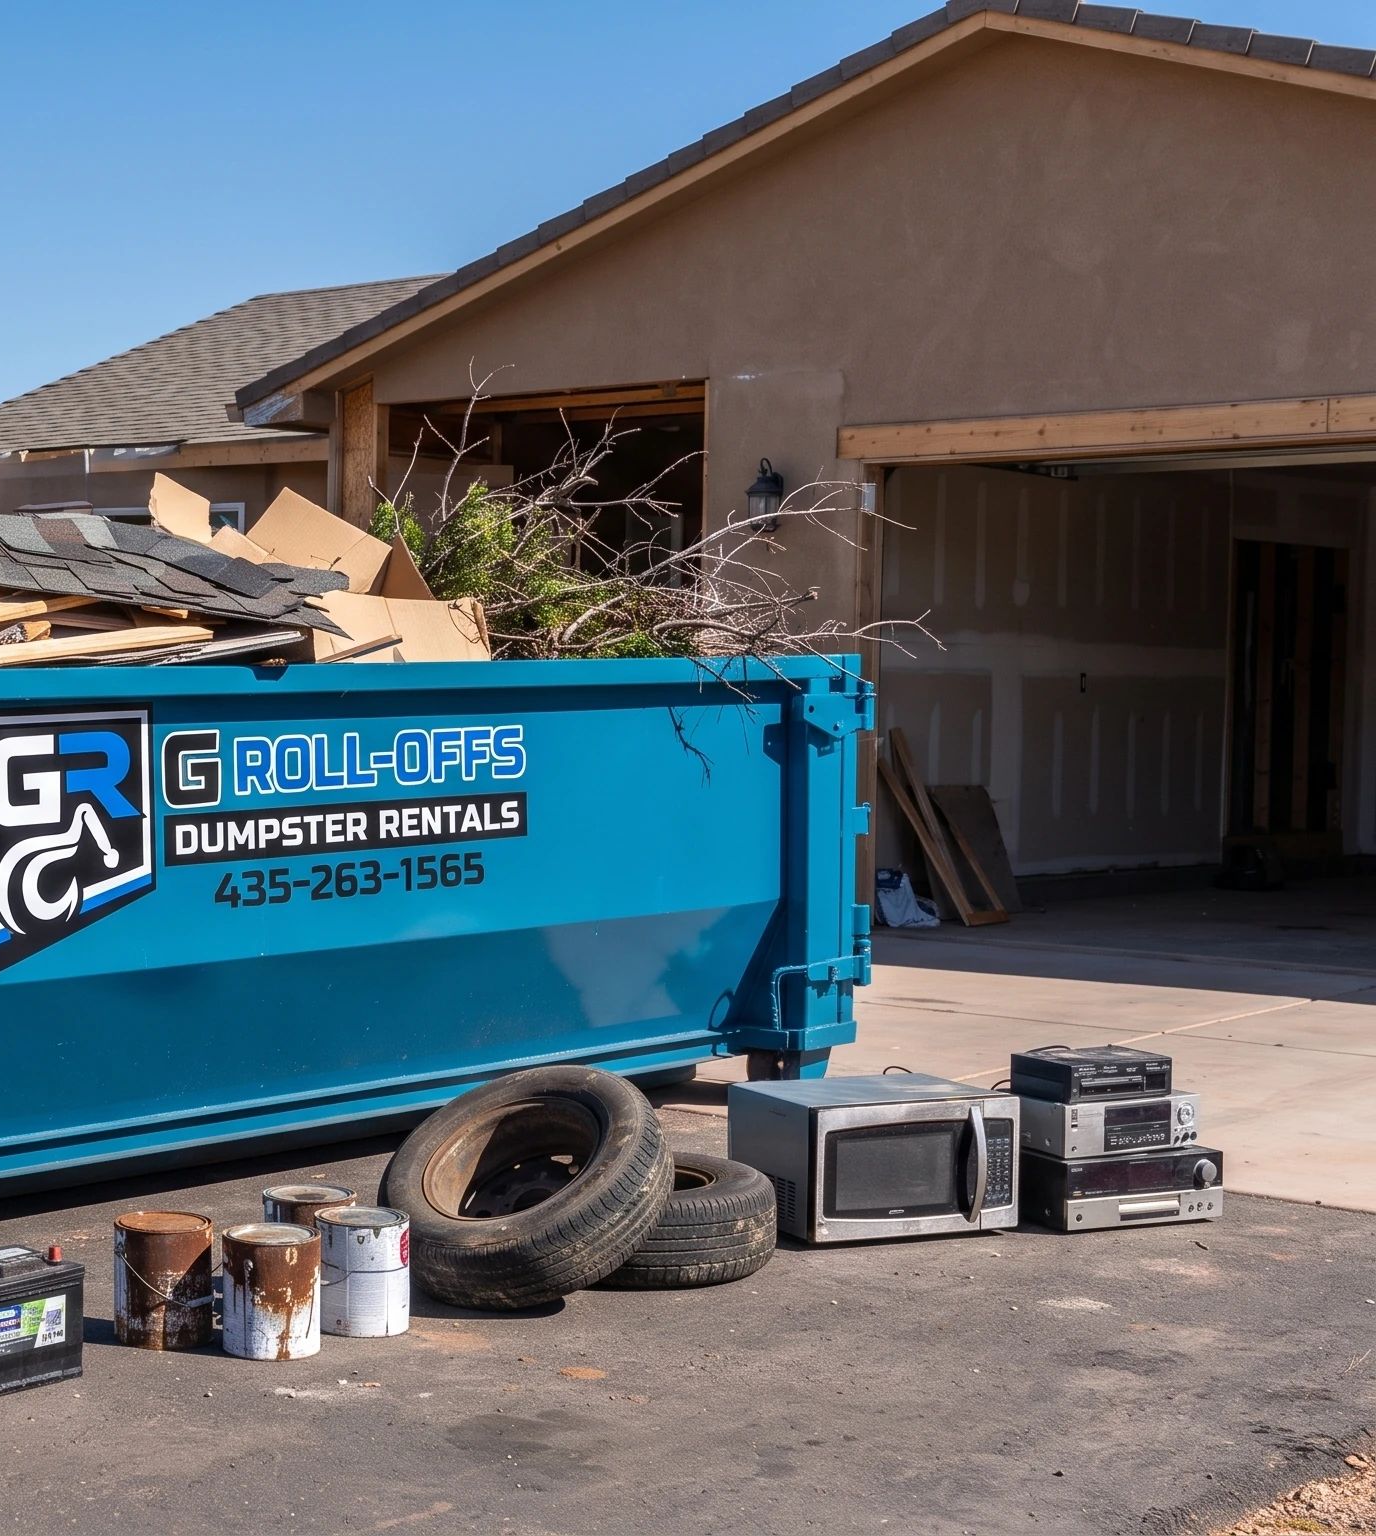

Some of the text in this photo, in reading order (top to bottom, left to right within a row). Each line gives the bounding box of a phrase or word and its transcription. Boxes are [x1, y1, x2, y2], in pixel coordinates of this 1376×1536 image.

[162, 725, 526, 808] G ROLL-OFFS
[175, 800, 520, 856] DUMPSTER RENTALS
[214, 852, 485, 908] 435-263-1565
